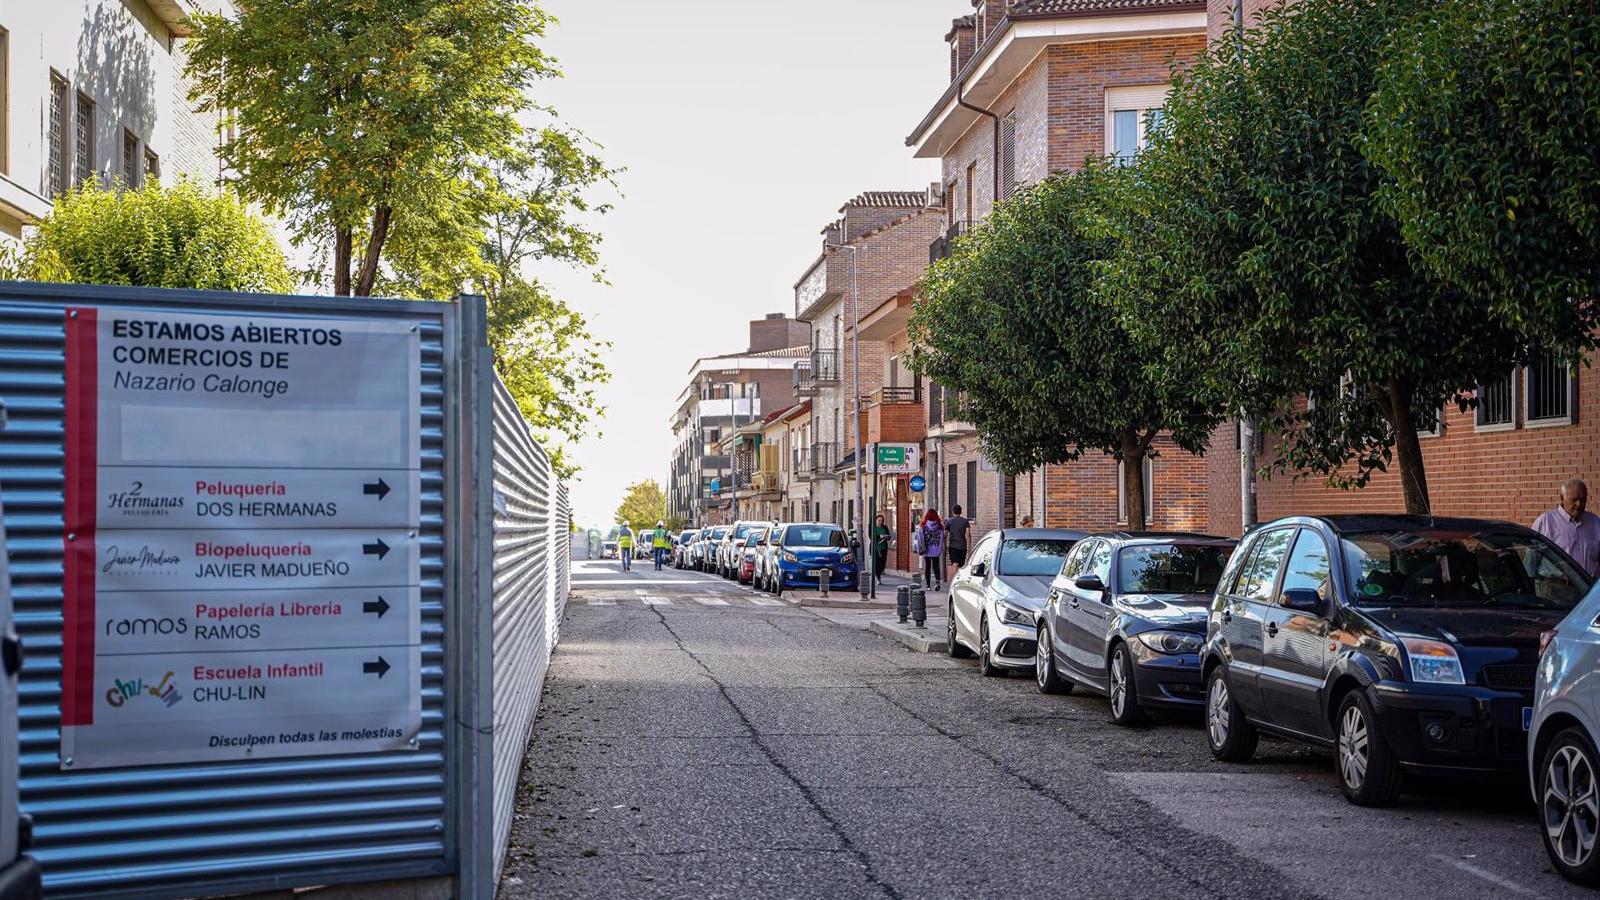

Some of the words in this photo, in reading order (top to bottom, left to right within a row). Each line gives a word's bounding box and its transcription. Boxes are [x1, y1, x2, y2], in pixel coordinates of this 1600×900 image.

[113, 320, 225, 342] ESTAMOS
[230, 325, 342, 346] ABIERTOS
[113, 346, 252, 368] COMERCIOS
[260, 352, 289, 369] DE
[113, 371, 195, 392] Nazario
[203, 374, 289, 398] Calonge
[129, 481, 143, 496] 2
[107, 492, 185, 508] Hermanas
[197, 502, 234, 516] DOS
[240, 502, 337, 516] HERMANAS
[195, 563, 256, 577] JAVIER
[262, 560, 350, 577] MADUEÑO
[106, 618, 188, 635] ramos
[195, 624, 260, 640] RAMOS
[193, 664, 262, 680] Escuela
[268, 662, 324, 678] Infantil
[193, 685, 266, 702] CHU-LIN
[209, 733, 275, 748] Disculpen
[280, 732, 315, 743] todas
[319, 730, 337, 742] las
[341, 727, 403, 741] molestias
